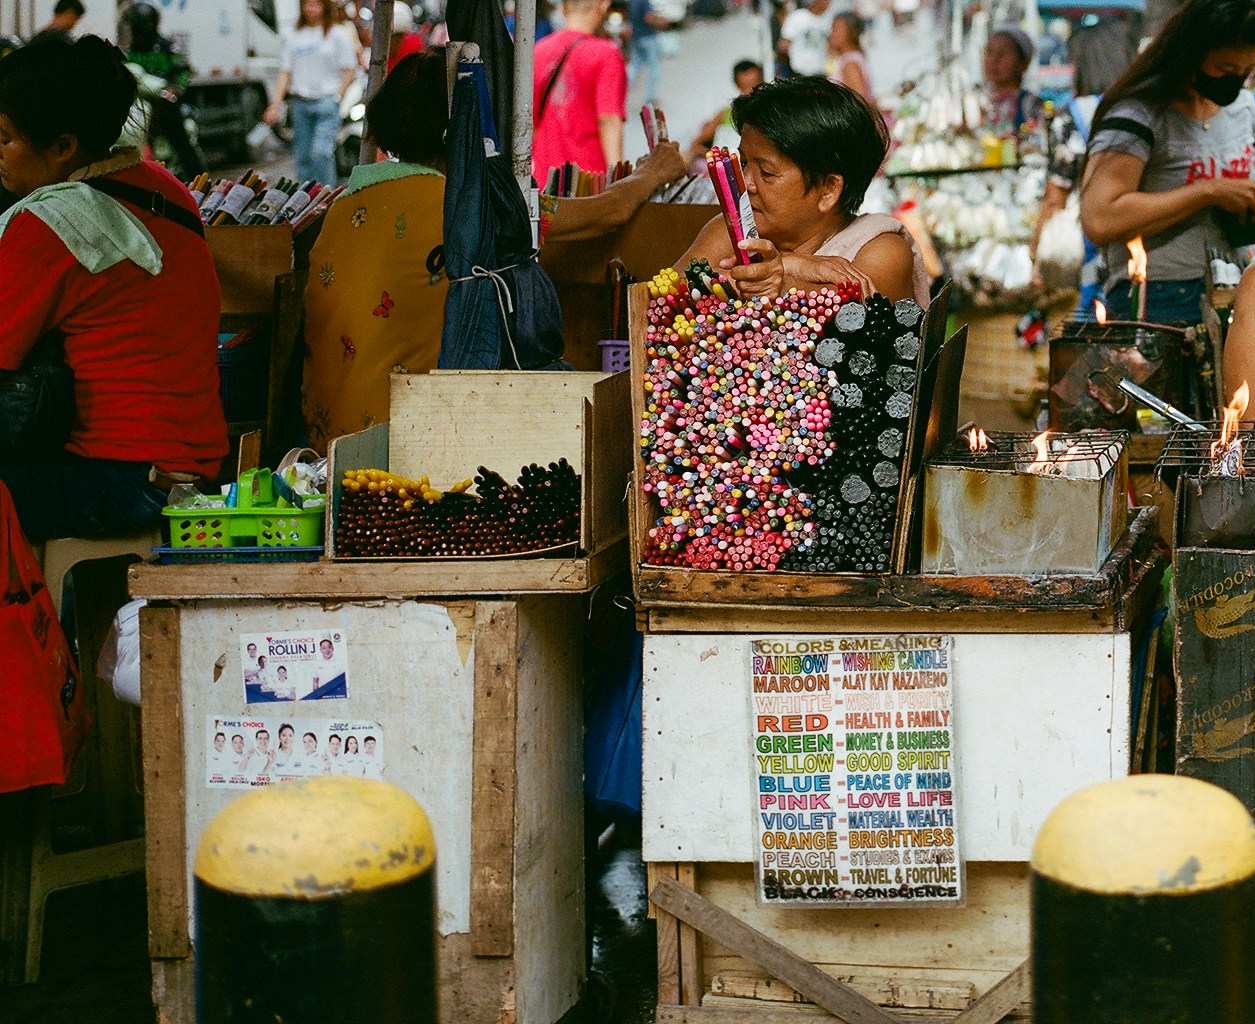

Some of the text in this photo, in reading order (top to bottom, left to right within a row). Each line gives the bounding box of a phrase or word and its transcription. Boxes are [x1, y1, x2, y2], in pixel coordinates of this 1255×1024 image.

[269, 644, 316, 655] ROLLIN J
[759, 640, 835, 654] COLORS
[753, 650, 948, 675] RAINBOW WISHING CANDLE
[754, 672, 948, 693] MAROON NAZARENO
[756, 693, 832, 714] WHITE
[758, 710, 950, 732] RED HEALTH FAMILY
[756, 730, 950, 754] GREEN MONEY BUSINESS
[758, 751, 950, 774] YELLOW GOOD SPIRIT
[759, 772, 950, 793] BLUE PEACE OF MIND
[760, 791, 952, 810] PINK LOVE LIFE
[761, 809, 953, 830] VIOLET MATERIAL WEALTH
[762, 829, 954, 850] ORANGE BRIGHTNESS
[763, 850, 899, 868] PEACH STUDIES
[764, 867, 956, 886] BROWN TRAVEL FORTUNE
[855, 886, 957, 899] CONSCIENCE
